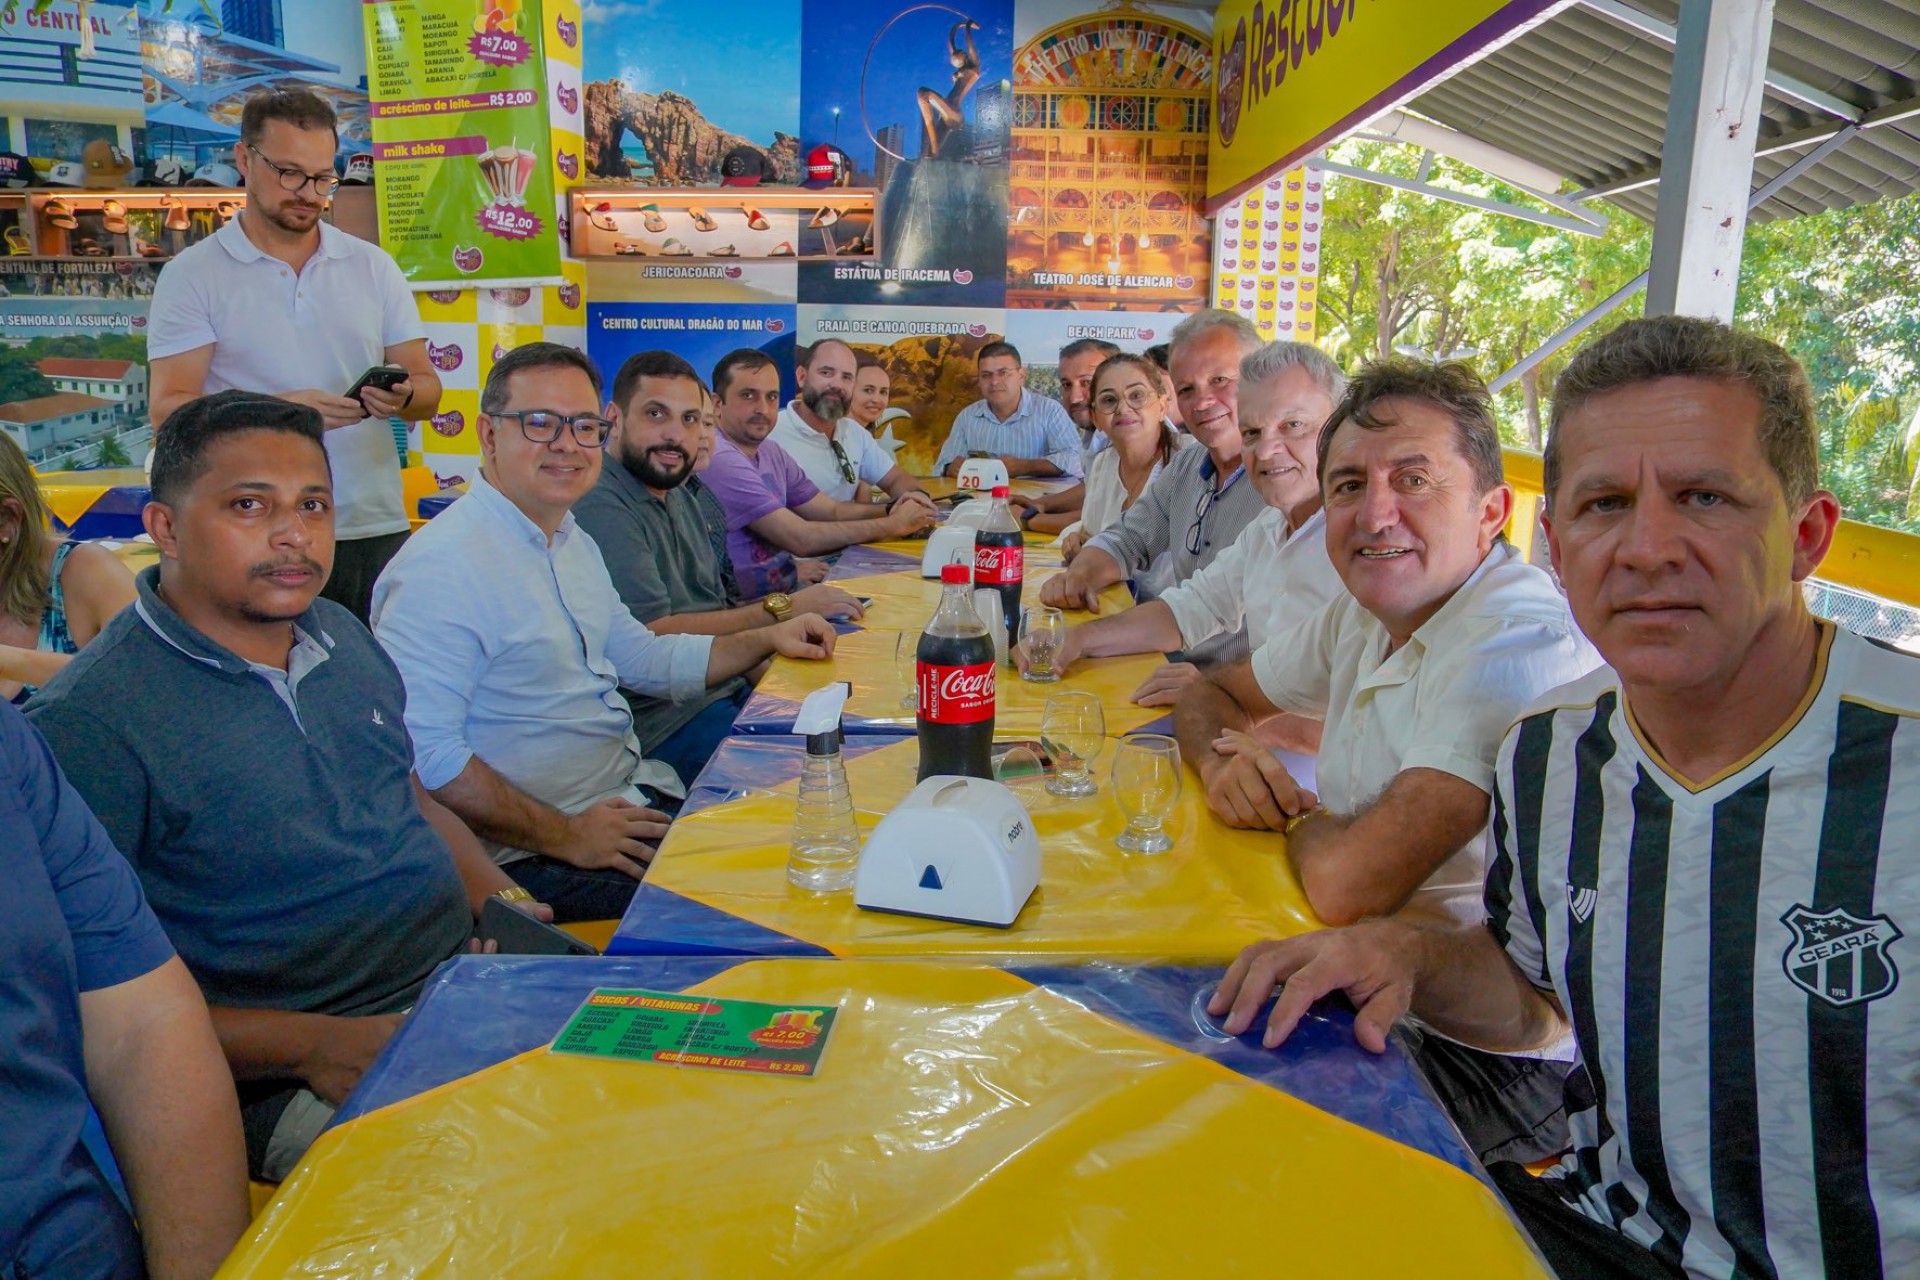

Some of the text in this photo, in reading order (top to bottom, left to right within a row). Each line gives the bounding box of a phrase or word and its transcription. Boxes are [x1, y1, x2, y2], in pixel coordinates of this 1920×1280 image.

[422, 14, 446, 22] MANGA
[422, 30, 458, 40] MORANGO
[424, 40, 448, 48] SAPOTI
[424, 48, 460, 57] SIRIGUELA
[1025, 34, 1088, 83] THEATRO
[1137, 30, 1156, 50] DE
[425, 56, 464, 66] TAMARINDO
[425, 66, 455, 74] LARANJA
[379, 78, 412, 88] GRAVIOLA
[426, 75, 458, 84] ABACAXI
[380, 101, 432, 115] acréscimo
[434, 101, 447, 110] de
[490, 94, 504, 107] R$
[506, 92, 532, 106] 2,00
[382, 143, 446, 158] milk shake
[387, 192, 424, 200] CHOCOLATE
[390, 226, 430, 234] OVOMALTINE
[41, 263, 55, 274] DE
[58, 262, 114, 274] FORTALEZA
[642, 266, 724, 279] JERICOACOARA
[834, 266, 881, 280] ESTÁTUA
[884, 269, 900, 280] DE
[901, 268, 951, 282] IRACEMA
[1033, 272, 1074, 286] TEATRO
[1077, 272, 1104, 286] JOSÉ
[1107, 274, 1122, 286] DE
[1124, 274, 1173, 288] ALENCAR
[8, 315, 56, 326] SENHORA
[58, 316, 72, 326] DA
[76, 312, 129, 328] ASSUNÇÃO
[602, 318, 638, 330] CENTRO
[640, 318, 686, 330] CULTURAL
[688, 316, 724, 330] DRAGÃO
[727, 319, 740, 330] DO
[742, 320, 763, 331] MAR
[816, 320, 850, 332] PRAIA
[852, 321, 867, 333] DE
[869, 322, 907, 334] CANOA
[910, 323, 967, 335] QUEBRADA
[1068, 326, 1104, 338] BEACH
[1106, 326, 1136, 339] PARK
[962, 476, 980, 488] 20
[1008, 820, 1022, 844] nobre
[1800, 928, 1880, 963] CEARÁ
[1832, 988, 1847, 998] 1914
[592, 995, 630, 1004] SUCOS
[630, 996, 640, 1005] /
[640, 998, 700, 1012] VITAMINAS
[710, 1057, 722, 1066] DE
[724, 1058, 747, 1068] LEITE
[769, 1062, 781, 1071] R$
